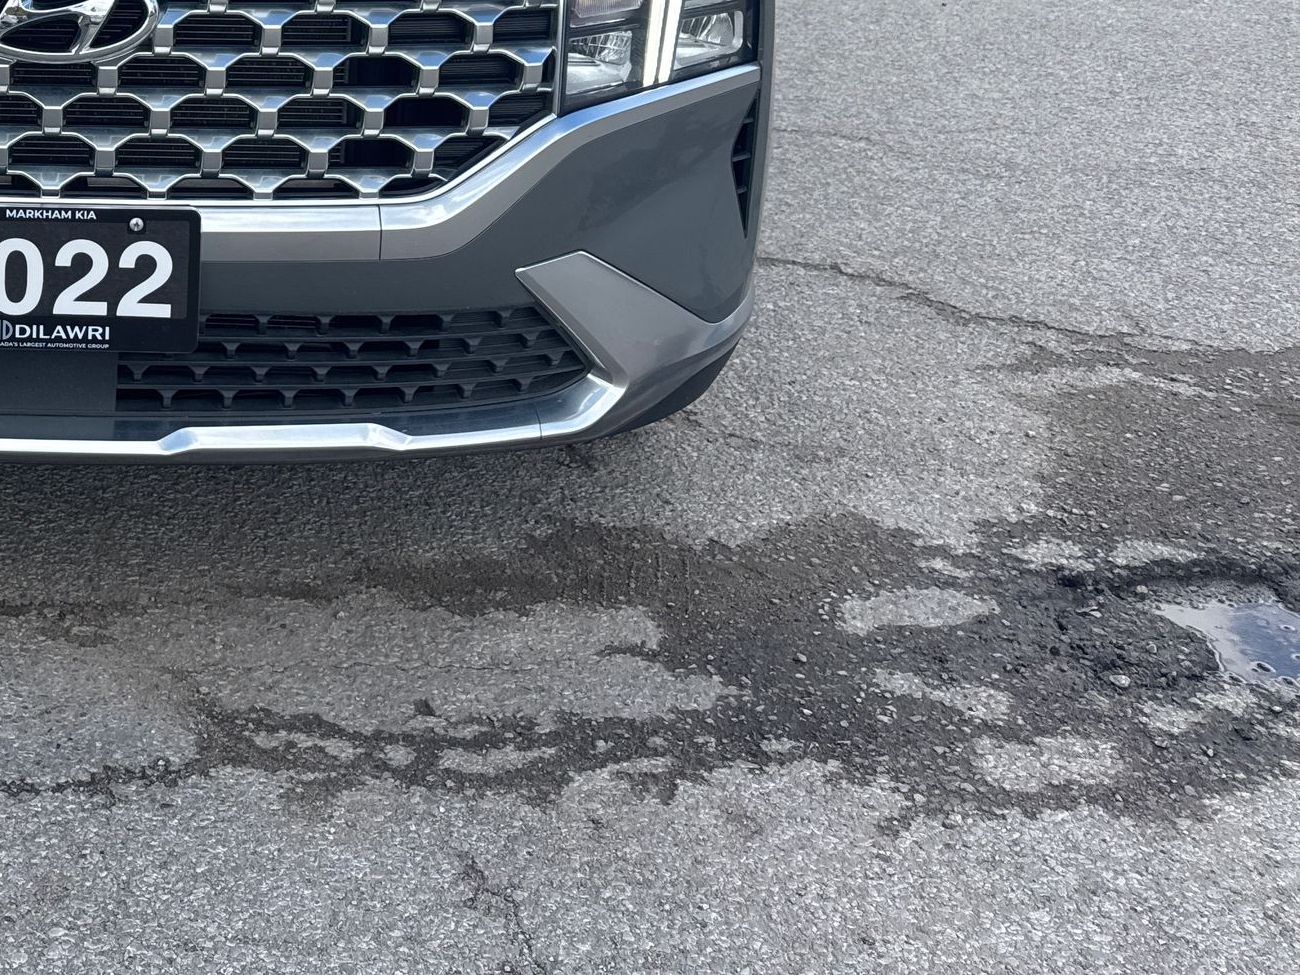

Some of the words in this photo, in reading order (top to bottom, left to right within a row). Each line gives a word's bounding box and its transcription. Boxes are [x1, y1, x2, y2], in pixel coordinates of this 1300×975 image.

[5, 208, 72, 219] MARKHAM
[75, 210, 97, 220] KIA
[15, 324, 110, 340] DILAWRI
